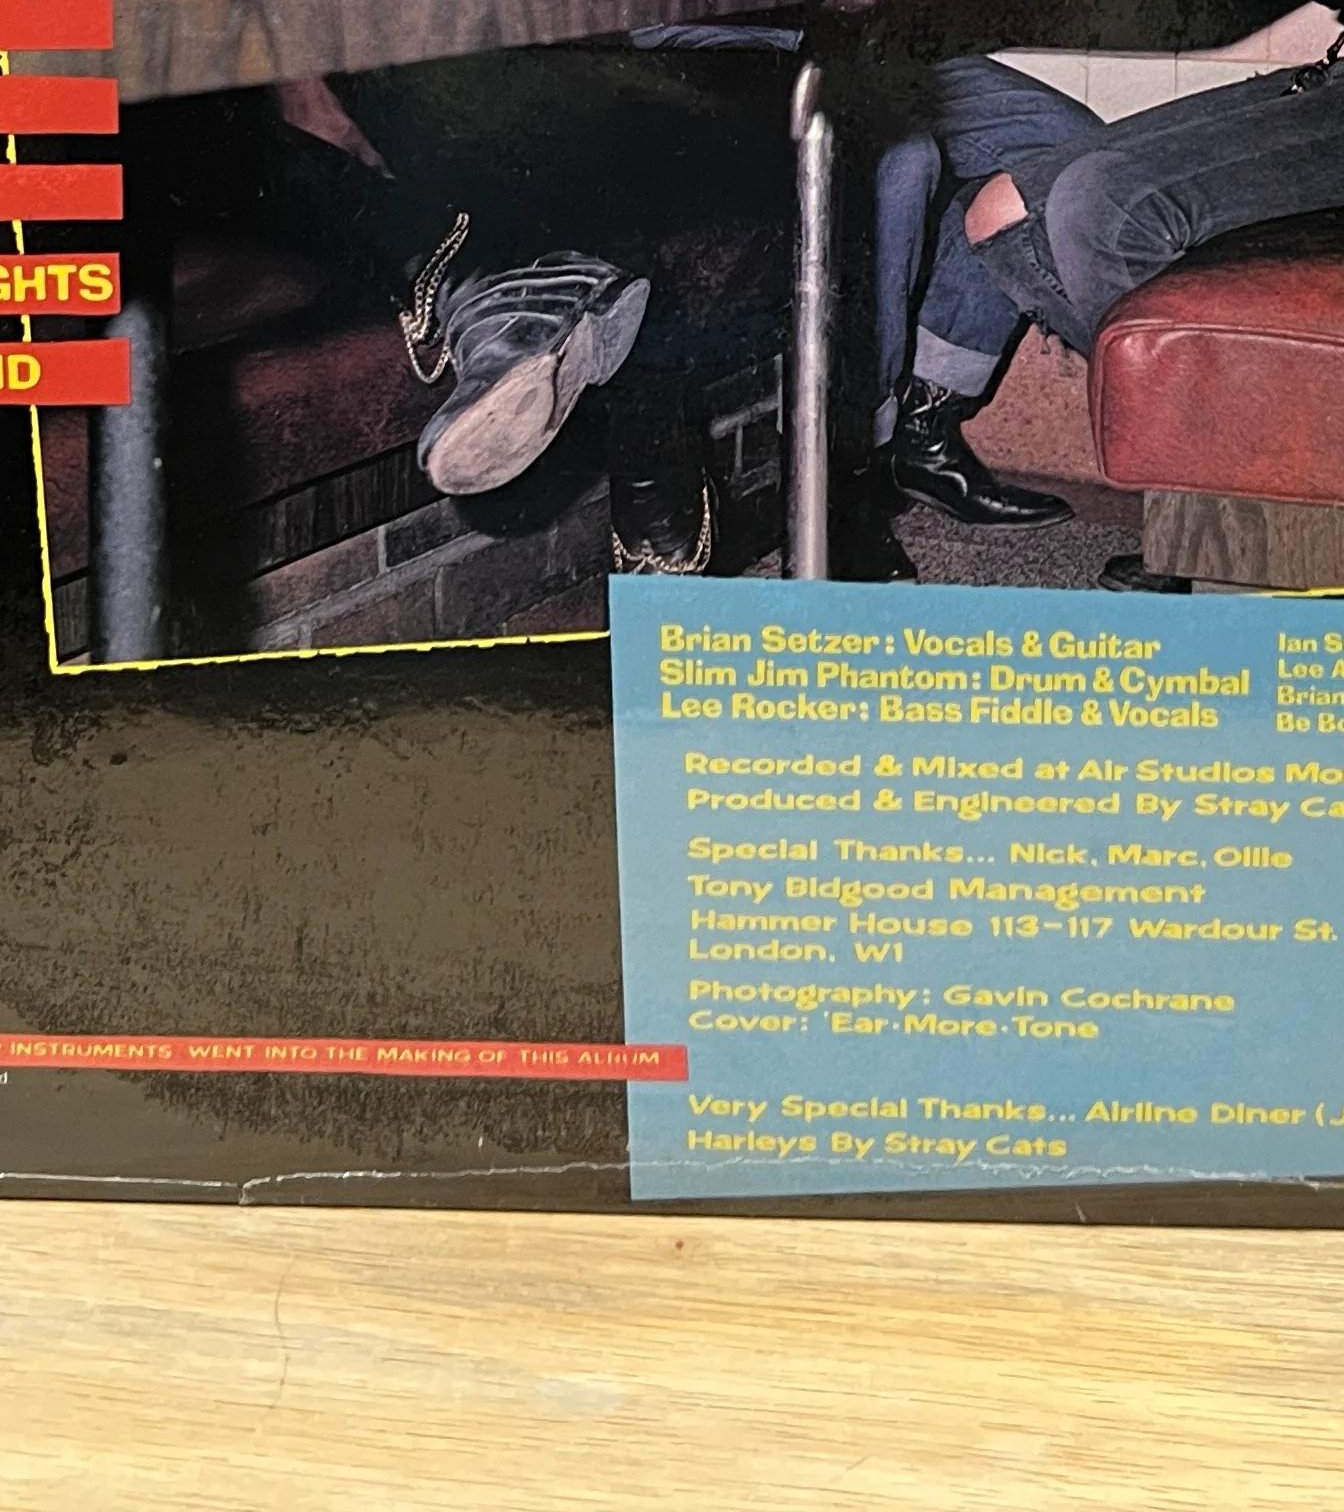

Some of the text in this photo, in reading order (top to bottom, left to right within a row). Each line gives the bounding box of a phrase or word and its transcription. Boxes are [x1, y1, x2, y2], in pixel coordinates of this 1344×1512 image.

[660, 624, 751, 652] Brian
[903, 628, 1014, 657] Vocals
[1021, 630, 1042, 657] &
[1048, 630, 1161, 660] Guitar
[1278, 632, 1318, 653] Ian
[659, 658, 737, 686] Slim
[747, 659, 809, 687] Jim
[990, 664, 1086, 693] Drum
[1092, 666, 1114, 693] &
[1119, 666, 1250, 702] Cymbal
[1277, 658, 1324, 679] Lee
[661, 691, 723, 719] Lee
[879, 694, 963, 723] Bass
[970, 696, 1073, 725] Fiddle
[1080, 699, 1102, 726] &
[1108, 699, 1219, 728] Vocals
[1276, 711, 1311, 732] Be
[684, 752, 861, 777] Recorded
[873, 754, 902, 777] &
[911, 755, 1023, 779] Mixed
[1034, 761, 1070, 780] at
[1077, 759, 1128, 781] Air
[1135, 759, 1275, 784] Studios
[687, 788, 861, 811] Produced
[872, 788, 902, 811] &
[913, 790, 1120, 821] Engineered
[1135, 792, 1181, 822] By
[1195, 793, 1290, 823] Stray
[687, 837, 818, 864] Special
[1213, 846, 1293, 868] Ollie
[687, 874, 1205, 912] Tony Bidgood Management
[691, 909, 837, 932] Hammer
[849, 911, 973, 937] House
[1129, 918, 1283, 940] Wardour
[854, 942, 903, 963] W1
[943, 984, 1049, 1007] Gavin
[1060, 987, 1235, 1012] Cochrane
[10, 1041, 172, 1059] INSTRUMENTS
[265, 1045, 318, 1060] INTO
[326, 1046, 370, 1061] THE
[377, 1047, 471, 1063] MAKING
[478, 1049, 505, 1063] OF
[520, 1049, 569, 1065] THIS
[688, 1094, 768, 1123] Very
[781, 1094, 908, 1123] Special
[1085, 1100, 1198, 1124] Airline
[1210, 1103, 1305, 1125] Diner
[687, 1130, 1067, 1161] Harleys By Stray Cats
